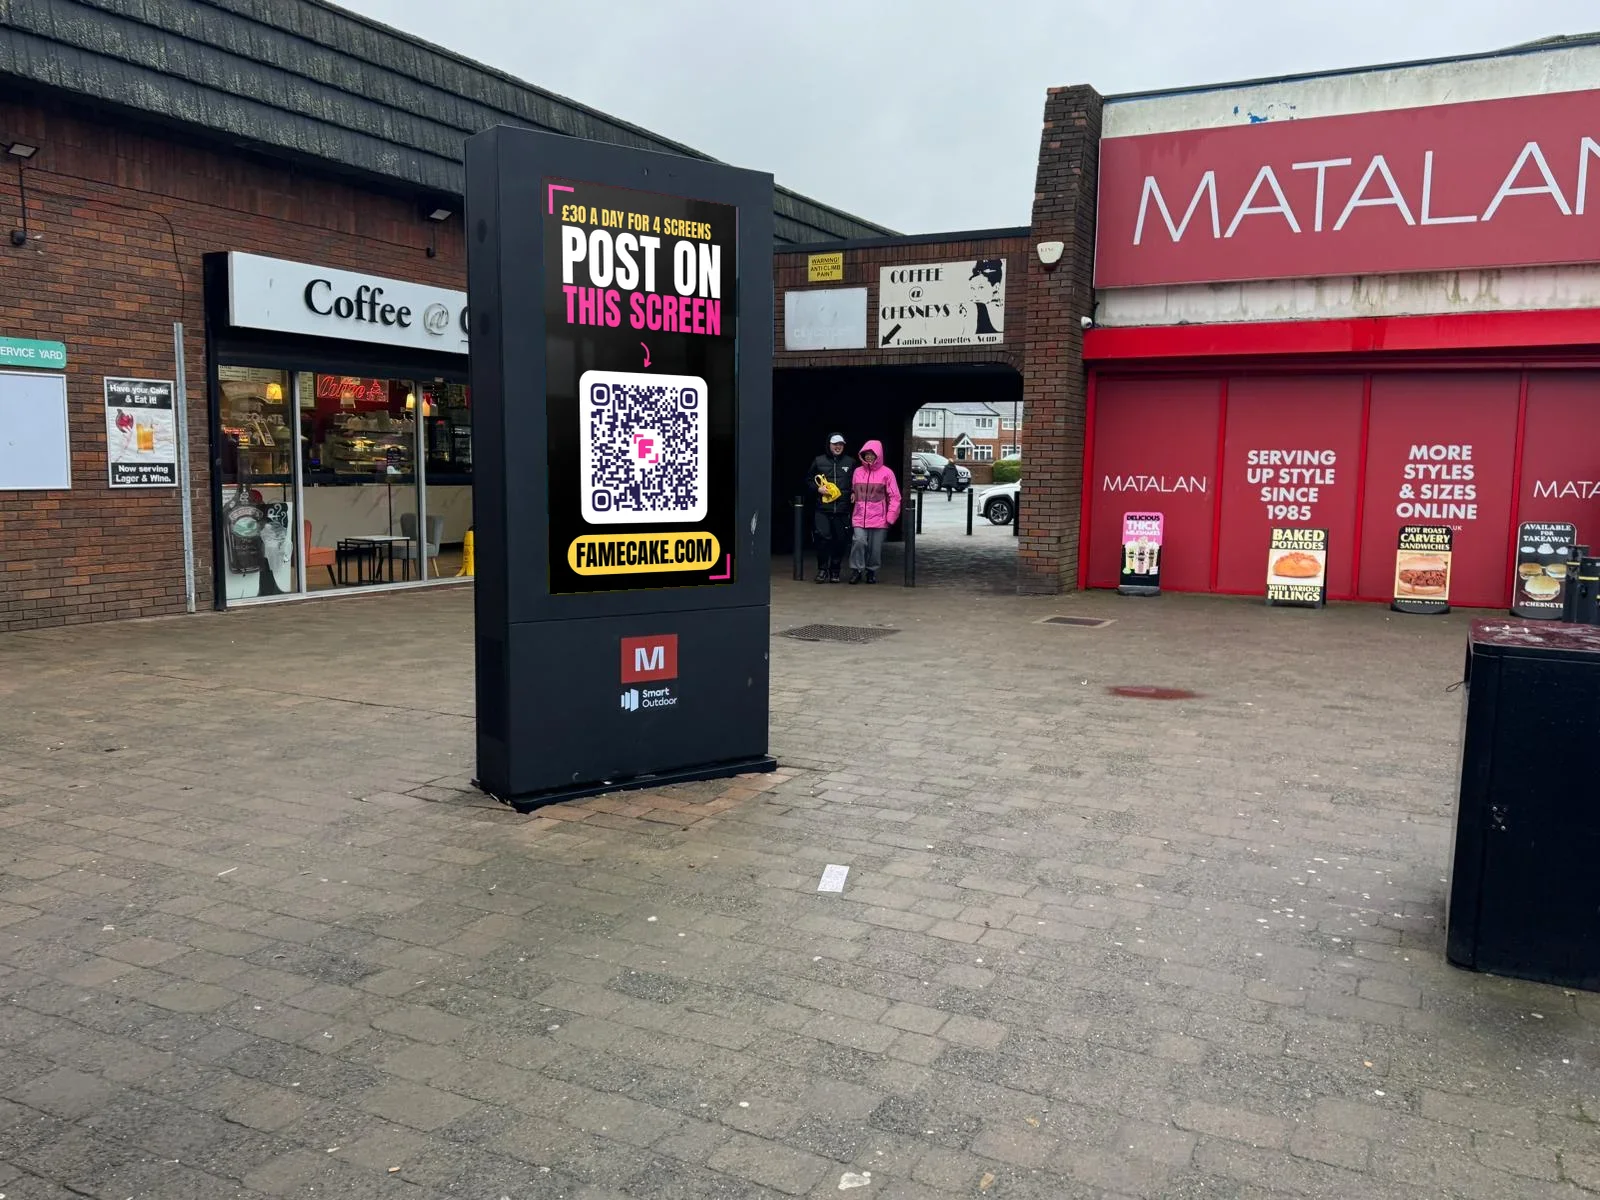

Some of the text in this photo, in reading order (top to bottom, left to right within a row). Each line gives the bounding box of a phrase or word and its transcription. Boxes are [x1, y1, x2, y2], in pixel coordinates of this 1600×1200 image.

[561, 204, 712, 240] £30 A DAY FOR 4 SCREENS
[561, 225, 721, 299] POST ON
[890, 267, 944, 284] COFFEE
[908, 286, 924, 302] @
[304, 278, 412, 328] Coffee
[423, 302, 449, 336] @
[562, 285, 721, 336] THIS SCREEN
[881, 303, 950, 320] CHESNEYS
[0, 346, 63, 360] ERVICE YARD
[109, 384, 169, 395] Have your Cake
[125, 394, 132, 403] &
[134, 395, 147, 404] Eat
[1247, 449, 1336, 465] SERVING
[1408, 444, 1473, 461] MORE
[118, 464, 169, 473] Now serving
[1247, 468, 1335, 484] UP STYLE
[1403, 463, 1475, 481] STYLES
[115, 474, 139, 483] Lager
[1103, 475, 1207, 493] MATALAN
[1260, 486, 1319, 503] SINCE
[1399, 483, 1477, 500] & SIZES
[1533, 479, 1600, 499] MATA
[1266, 504, 1312, 520] 1985
[1396, 502, 1478, 520] ONLINE
[1126, 520, 1160, 531] THICK
[1524, 523, 1572, 532] AVAILABLE
[1272, 528, 1325, 542] BAKED
[1400, 533, 1450, 543] CARVERY
[1523, 535, 1571, 543] TAKEAWAY
[576, 538, 712, 568] FAMECAKE.COM
[1272, 541, 1324, 550] POTATOES
[1400, 542, 1450, 550] SANDWICHES
[1267, 590, 1320, 602] FILLINGS
[642, 687, 670, 698] Smart
[642, 697, 678, 708] Outdoor
